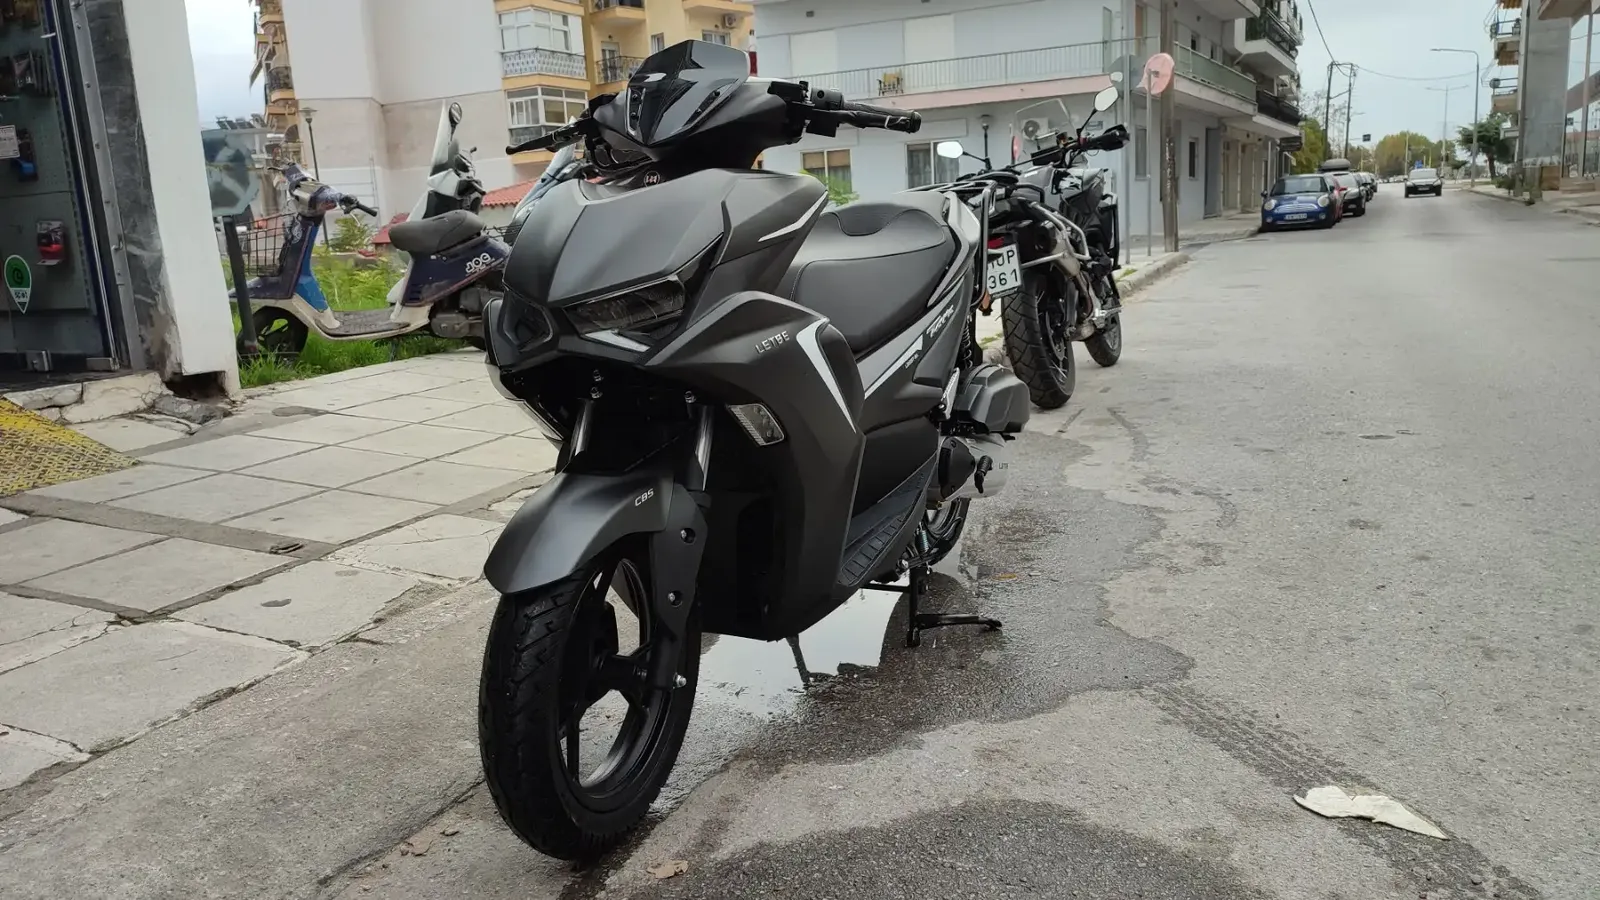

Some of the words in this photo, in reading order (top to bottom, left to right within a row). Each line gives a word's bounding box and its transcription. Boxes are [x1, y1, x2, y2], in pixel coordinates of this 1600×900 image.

[465, 252, 491, 273] JOG
[988, 269, 1018, 289] 361
[755, 330, 790, 353] LETBE
[635, 488, 654, 506] CBS
